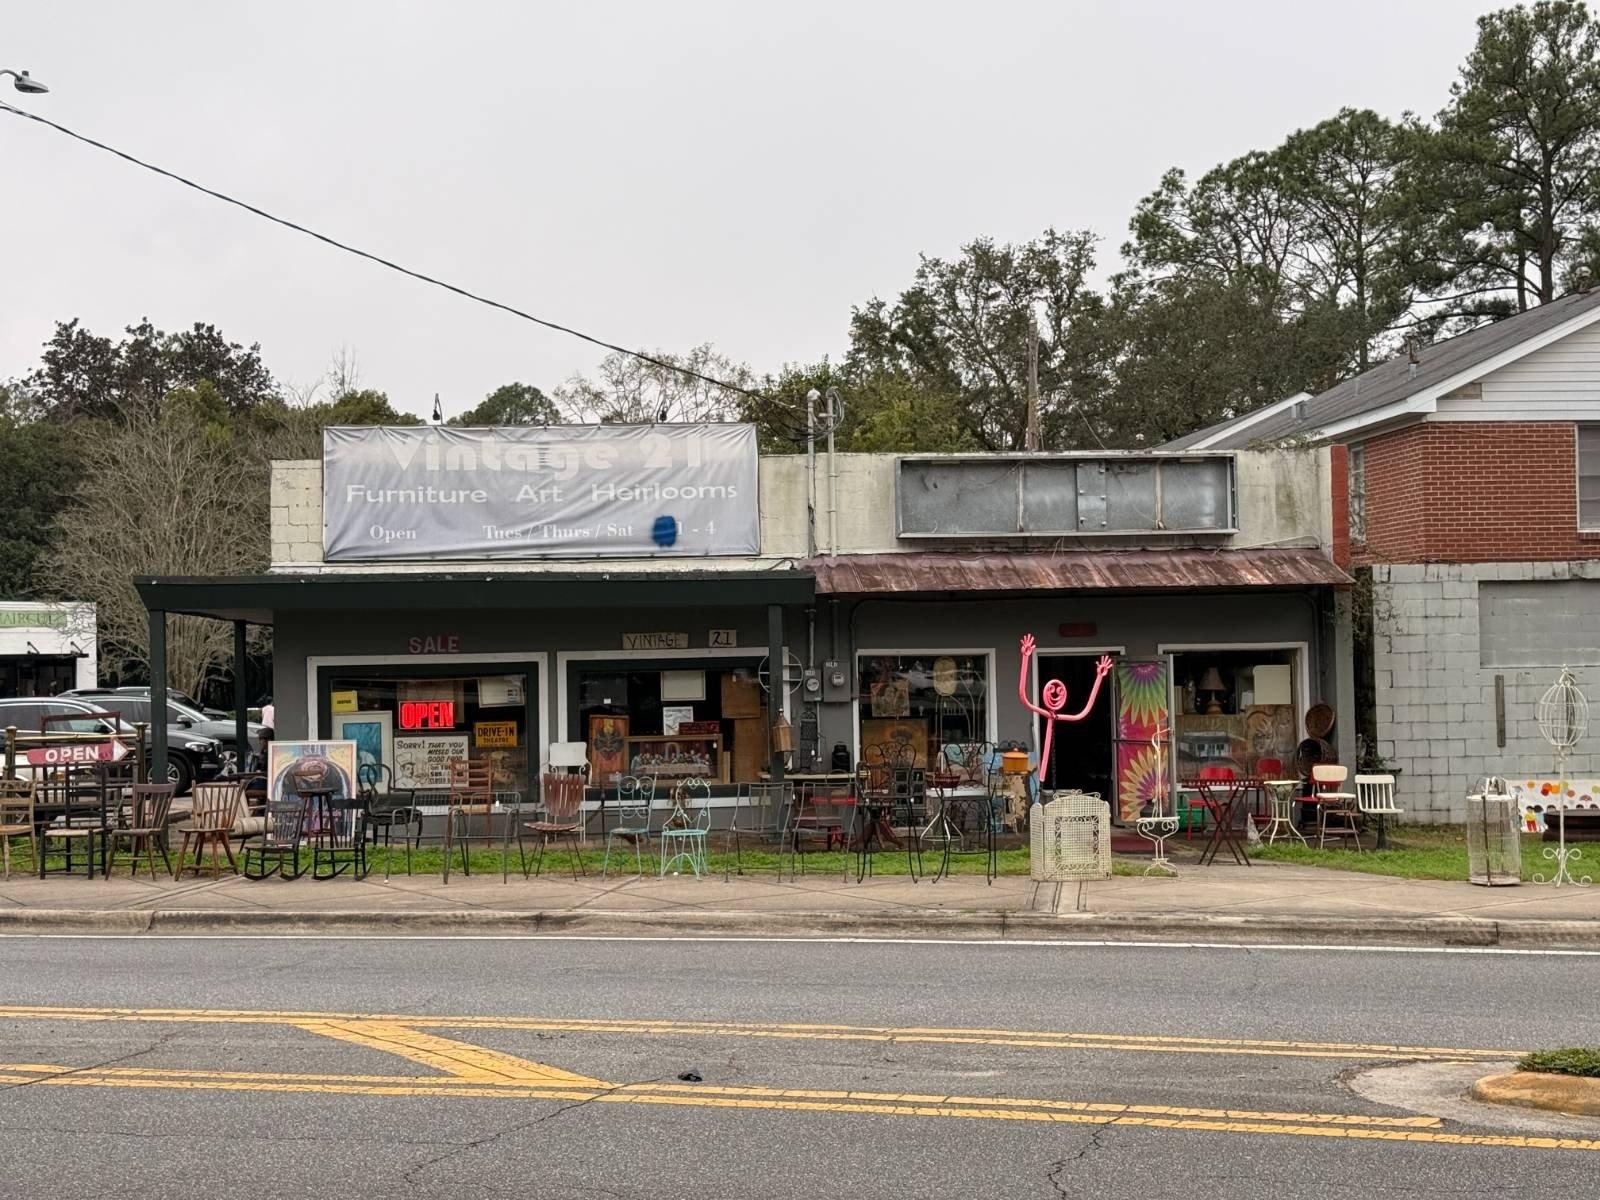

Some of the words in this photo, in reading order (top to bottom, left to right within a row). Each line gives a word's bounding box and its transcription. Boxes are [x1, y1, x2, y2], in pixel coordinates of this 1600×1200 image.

[387, 434, 618, 480] Vintage
[639, 433, 703, 468] 21
[346, 484, 488, 504] Furniture
[515, 485, 563, 503] Art
[591, 482, 738, 502] Heirlooms
[369, 525, 417, 543] Open
[483, 524, 522, 540] Tues
[540, 523, 590, 539] Thurs
[607, 522, 634, 538] Sat
[408, 636, 460, 654] SALE
[626, 633, 682, 649] VINTAGE
[711, 630, 733, 646] 21
[401, 702, 455, 729] OPEN
[477, 726, 515, 737] DRIVE-IN
[45, 745, 99, 763] OPEN
